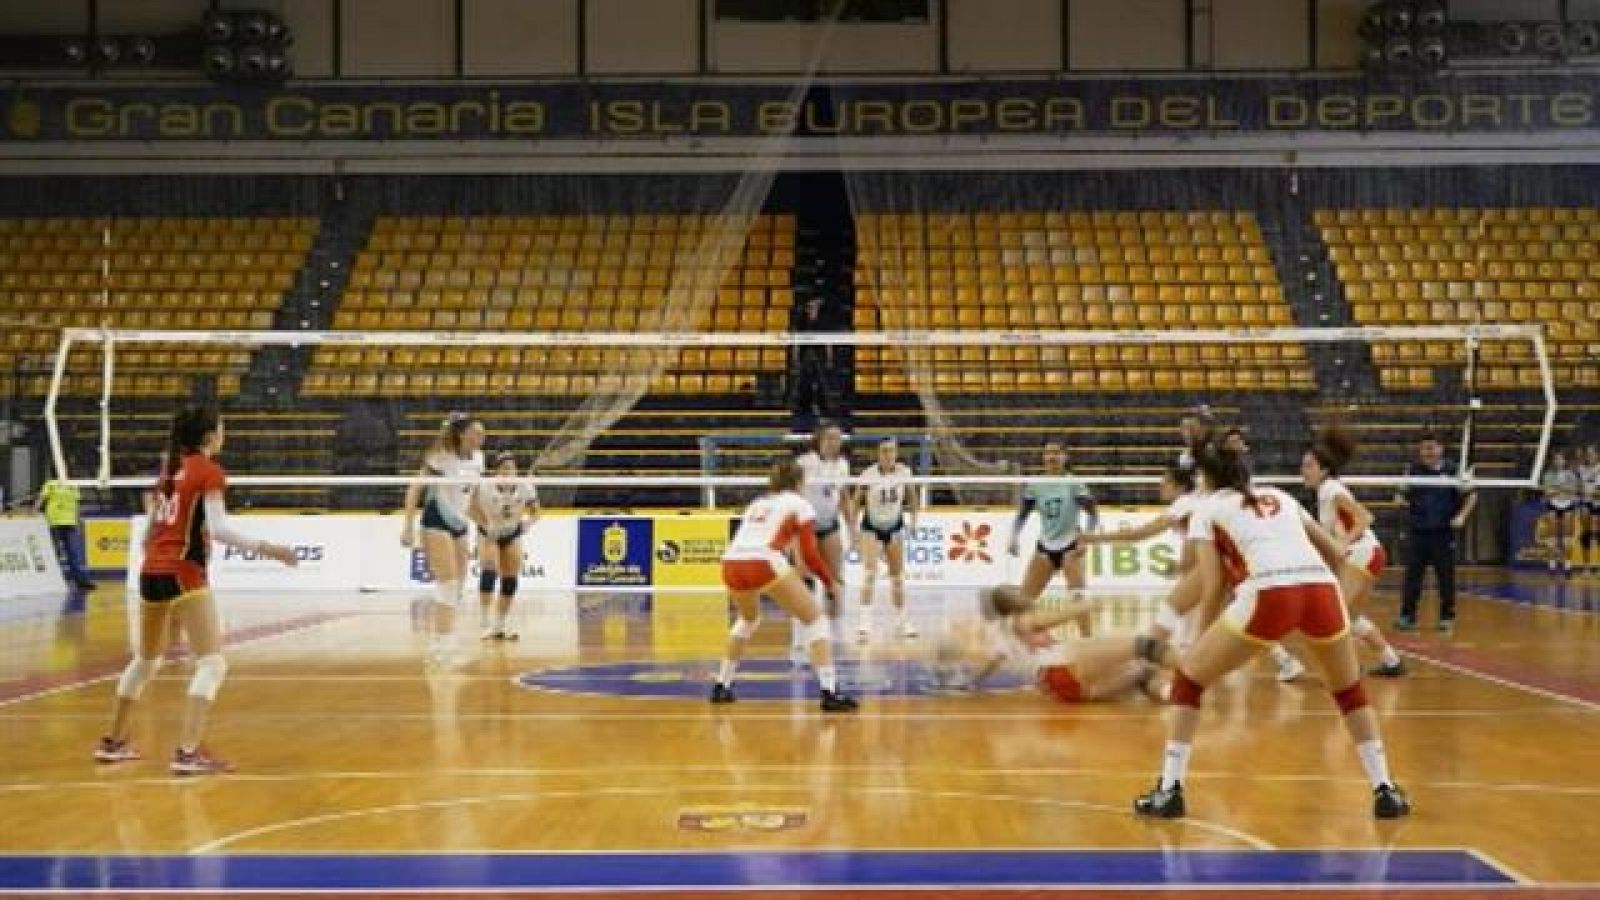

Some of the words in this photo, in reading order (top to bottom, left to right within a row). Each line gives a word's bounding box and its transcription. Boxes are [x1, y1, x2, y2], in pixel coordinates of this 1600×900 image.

[65, 96, 240, 136] Gran
[264, 90, 543, 136] Canaria
[589, 100, 732, 132] ISLA
[757, 98, 1083, 133] EUROPEA
[1110, 95, 1240, 129] DEL
[1265, 94, 1590, 127] DEPORTE
